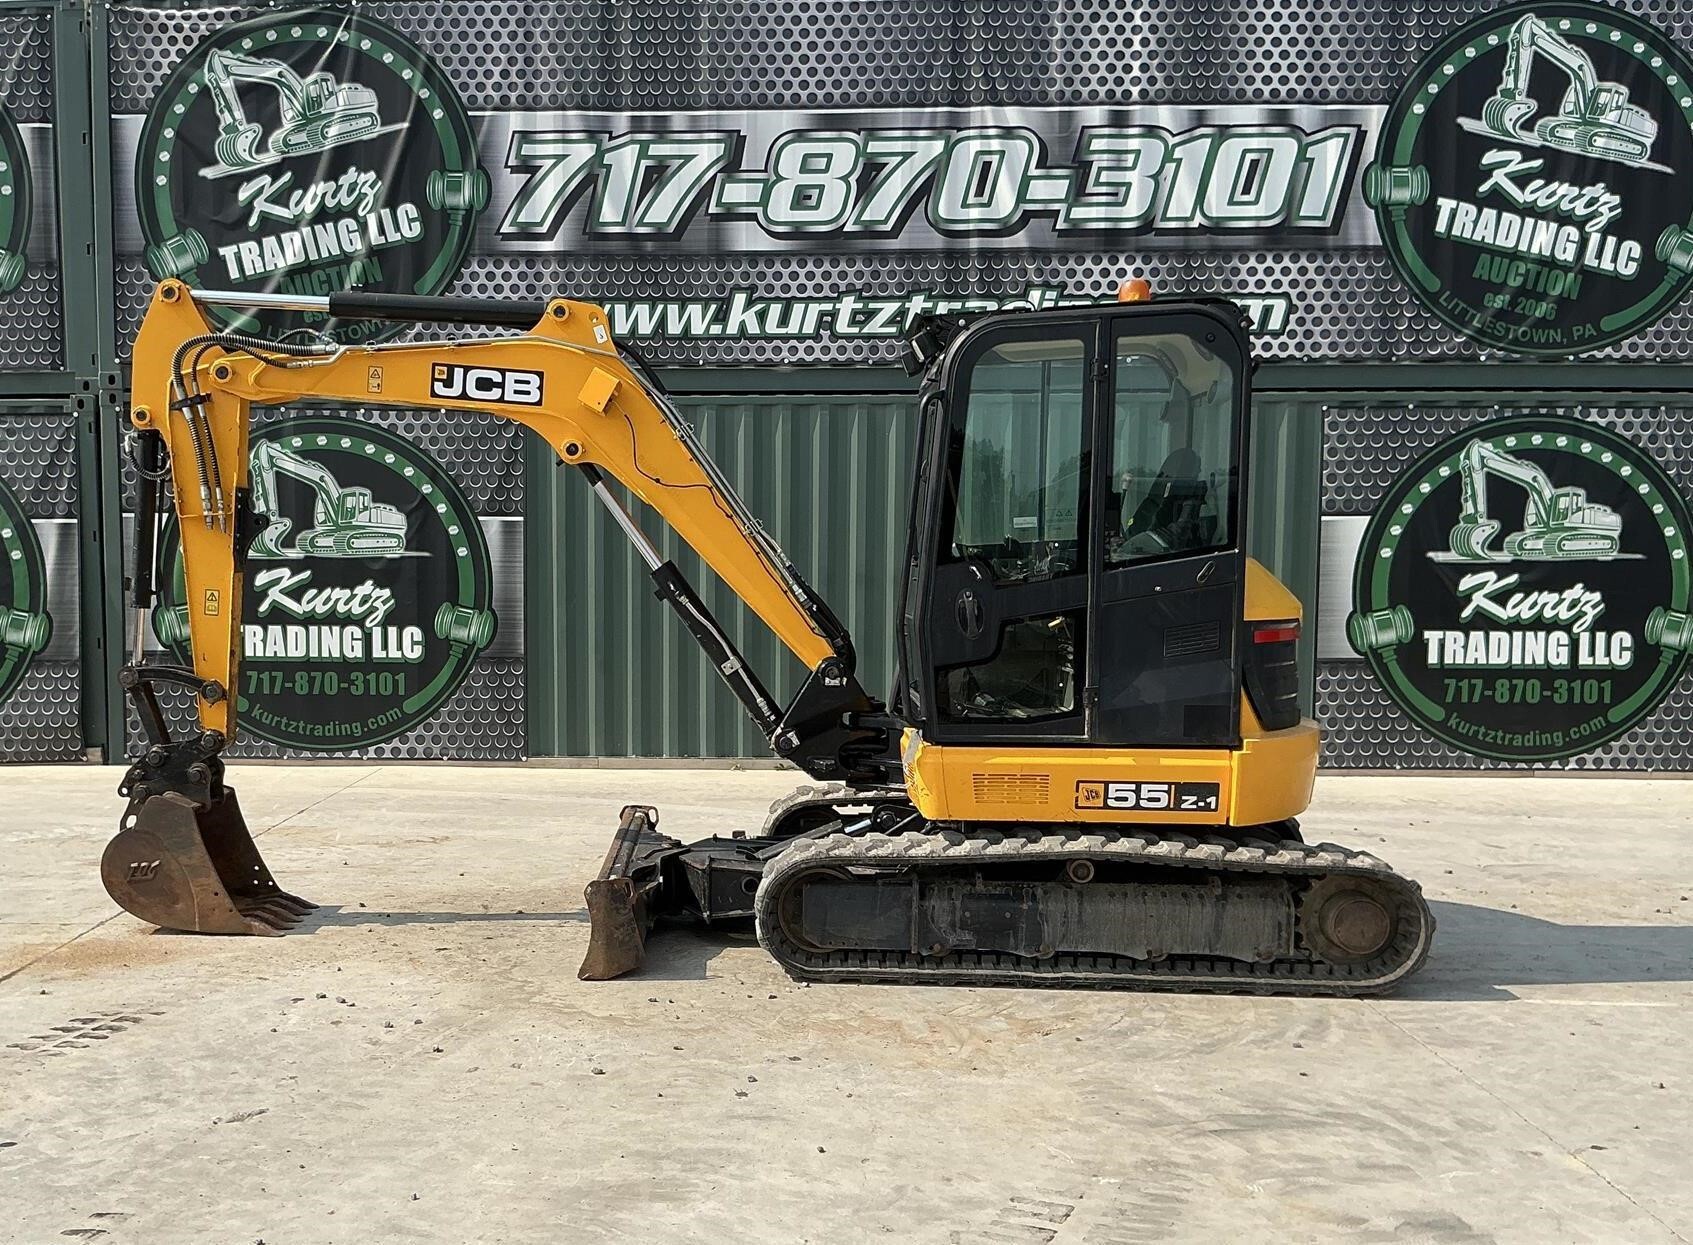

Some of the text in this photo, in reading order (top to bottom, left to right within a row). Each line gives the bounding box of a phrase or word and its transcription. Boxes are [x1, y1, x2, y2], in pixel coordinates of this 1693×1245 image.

[238, 166, 383, 227] Kurtz
[497, 125, 1358, 237] 717-870-3101
[1477, 149, 1622, 233] Kurtz
[218, 202, 422, 280] TRADING LLC
[1434, 197, 1642, 276] TRADING LLC
[1472, 252, 1584, 301] AUCTION
[1438, 291, 1598, 345] LITTLESTOWN, PA
[1513, 297, 1558, 321] 2006
[432, 366, 541, 404] JCB
[253, 567, 396, 628] Kurtz
[1458, 571, 1605, 634] Kurtz
[241, 624, 424, 660] RADING LLC
[1423, 630, 1634, 666] TRADING LLC
[246, 671, 406, 696] 717-870-3101
[1443, 678, 1612, 704] 717-870-3101
[251, 703, 403, 737] kurtztrading.com
[1447, 713, 1607, 747] kurtztrading.com
[1106, 783, 1169, 809] 55
